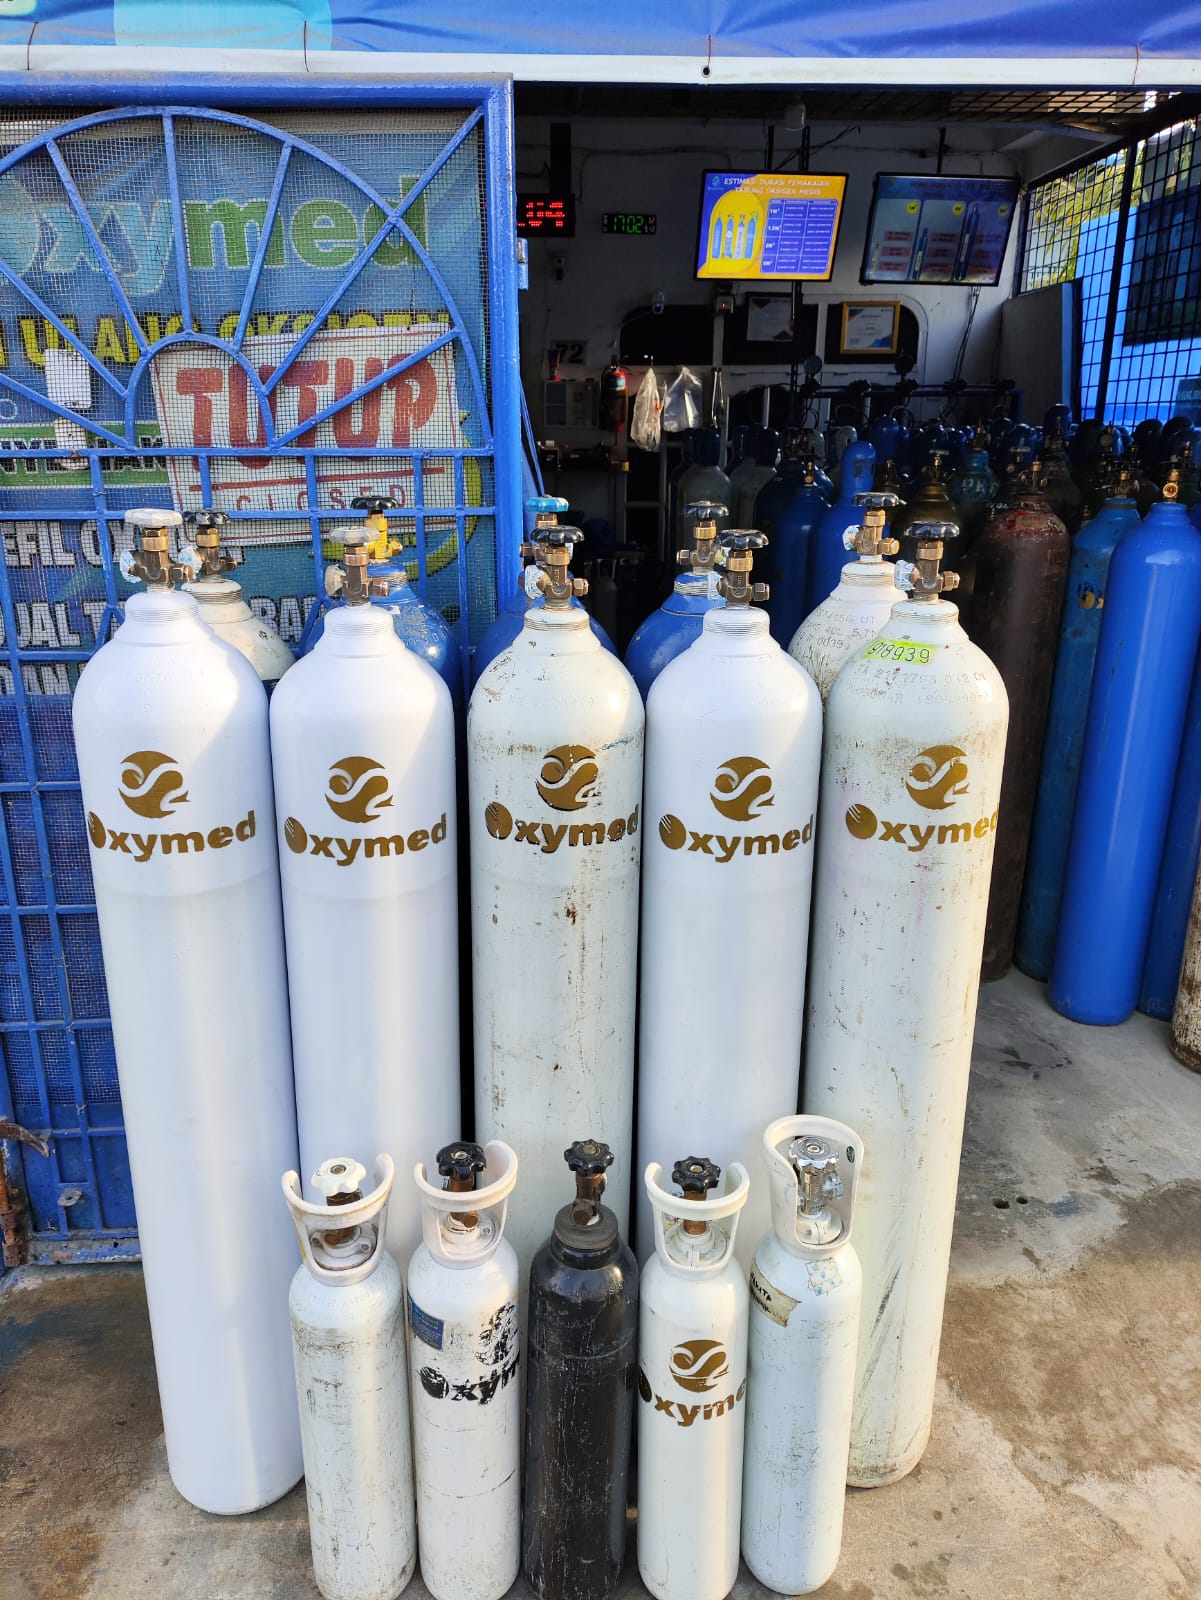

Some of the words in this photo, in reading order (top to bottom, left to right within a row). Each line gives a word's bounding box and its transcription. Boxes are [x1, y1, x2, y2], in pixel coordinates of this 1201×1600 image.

[176, 352, 438, 472] TUTUP
[87, 809, 256, 862] Oxymed
[284, 813, 447, 866] Oxymed
[484, 802, 640, 854] Oxymed
[659, 813, 815, 863] Oxymed
